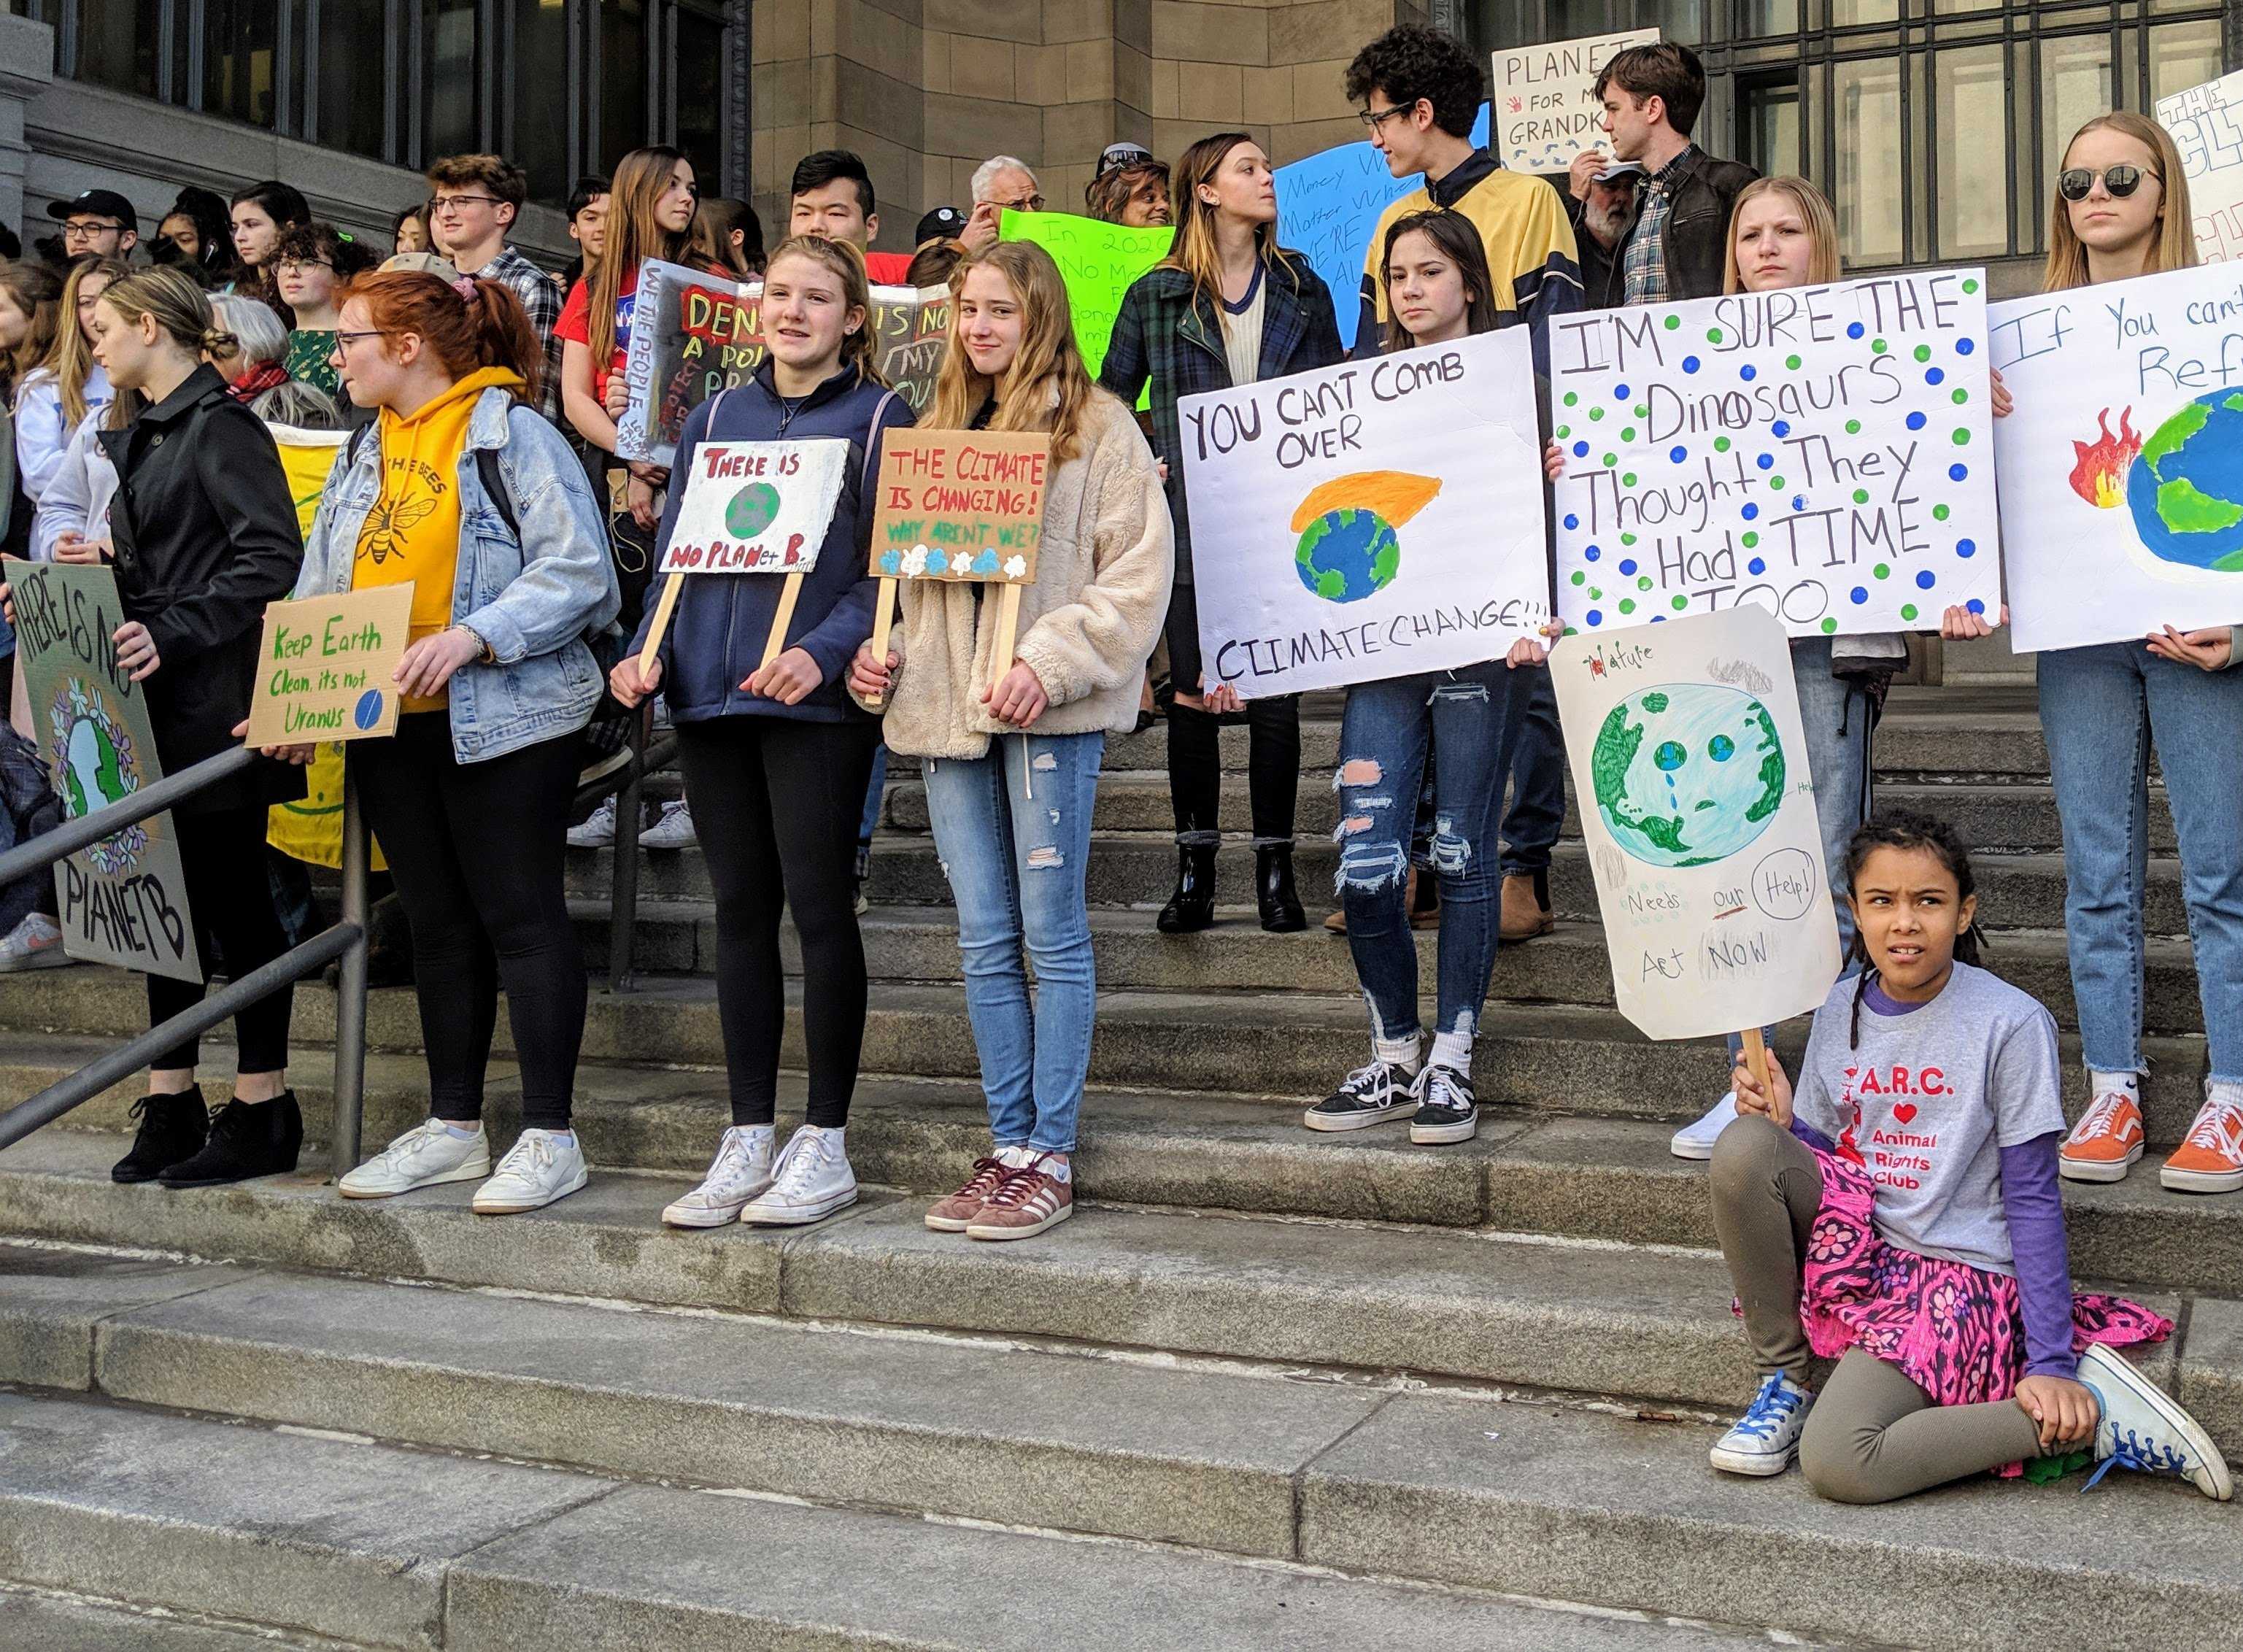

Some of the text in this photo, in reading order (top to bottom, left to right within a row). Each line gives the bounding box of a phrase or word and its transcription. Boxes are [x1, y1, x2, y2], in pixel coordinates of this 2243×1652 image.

[1531, 92, 1564, 112] FOR
[2157, 80, 2228, 125] THE
[1509, 110, 1603, 145] GRANDK
[1285, 169, 1345, 207] Money
[1042, 220, 1173, 254] In 2020
[1308, 215, 1362, 270] E'RE
[1061, 255, 1100, 280] No
[689, 293, 765, 340] DEN
[1559, 274, 1958, 375] I'M SURE THE
[1991, 304, 2074, 371] If
[2104, 297, 2160, 350] You
[682, 336, 703, 360] A
[900, 344, 939, 376] MY
[2139, 333, 2243, 396] Ref
[1186, 397, 1262, 461] YOU
[1276, 414, 1362, 469] OVER
[417, 460, 448, 495] BEES
[703, 447, 800, 479] THERE IS
[889, 445, 1046, 485] THE CLIMATE
[886, 485, 1038, 516] IS CHANGING!
[1569, 434, 1918, 536] Thought They
[887, 519, 926, 544] WHY
[997, 520, 1040, 549] WE?
[1656, 496, 1930, 588] Had TIME
[668, 544, 703, 568] NO
[1691, 579, 1829, 624] TOO
[62, 577, 93, 664] IS
[273, 614, 382, 661] Keep Earth
[344, 668, 367, 690] not
[284, 701, 347, 734] Uranus
[1627, 890, 1680, 915] Needs
[1765, 868, 1810, 905] Help!
[1860, 1066, 1955, 1095] A.R.C.
[1872, 1129, 1937, 1148] Animal
[1875, 1151, 1931, 1171] Rights
[1873, 1171, 1920, 1190] Club
